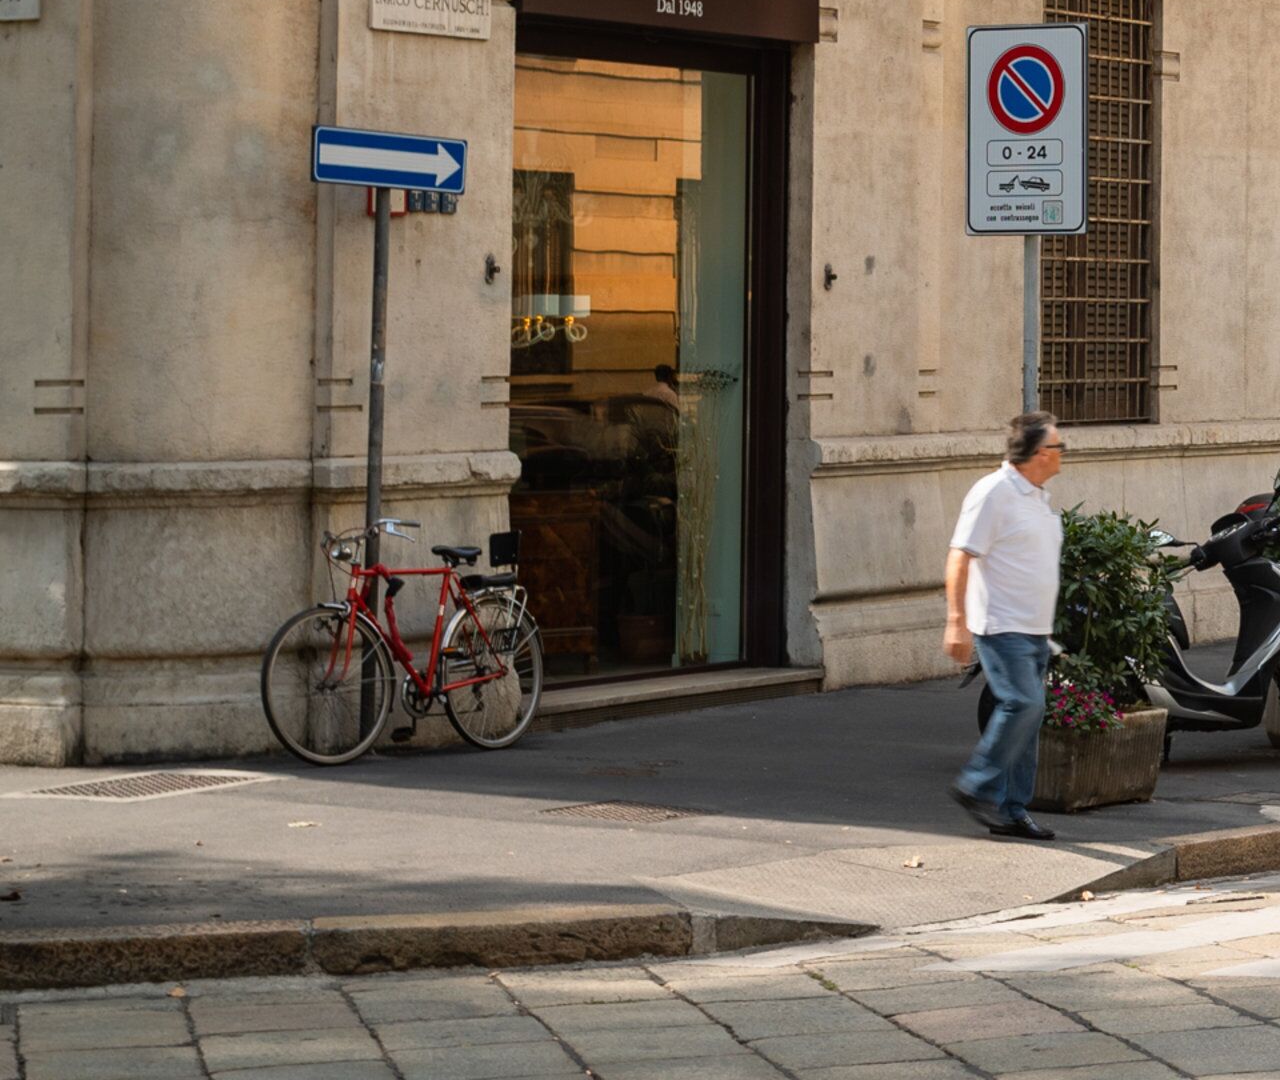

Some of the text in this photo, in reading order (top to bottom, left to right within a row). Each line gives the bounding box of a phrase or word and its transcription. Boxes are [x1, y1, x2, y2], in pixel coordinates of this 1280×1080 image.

[678, 0, 703, 17] 1948
[1002, 146, 1012, 160] 0
[1027, 145, 1047, 159] 24
